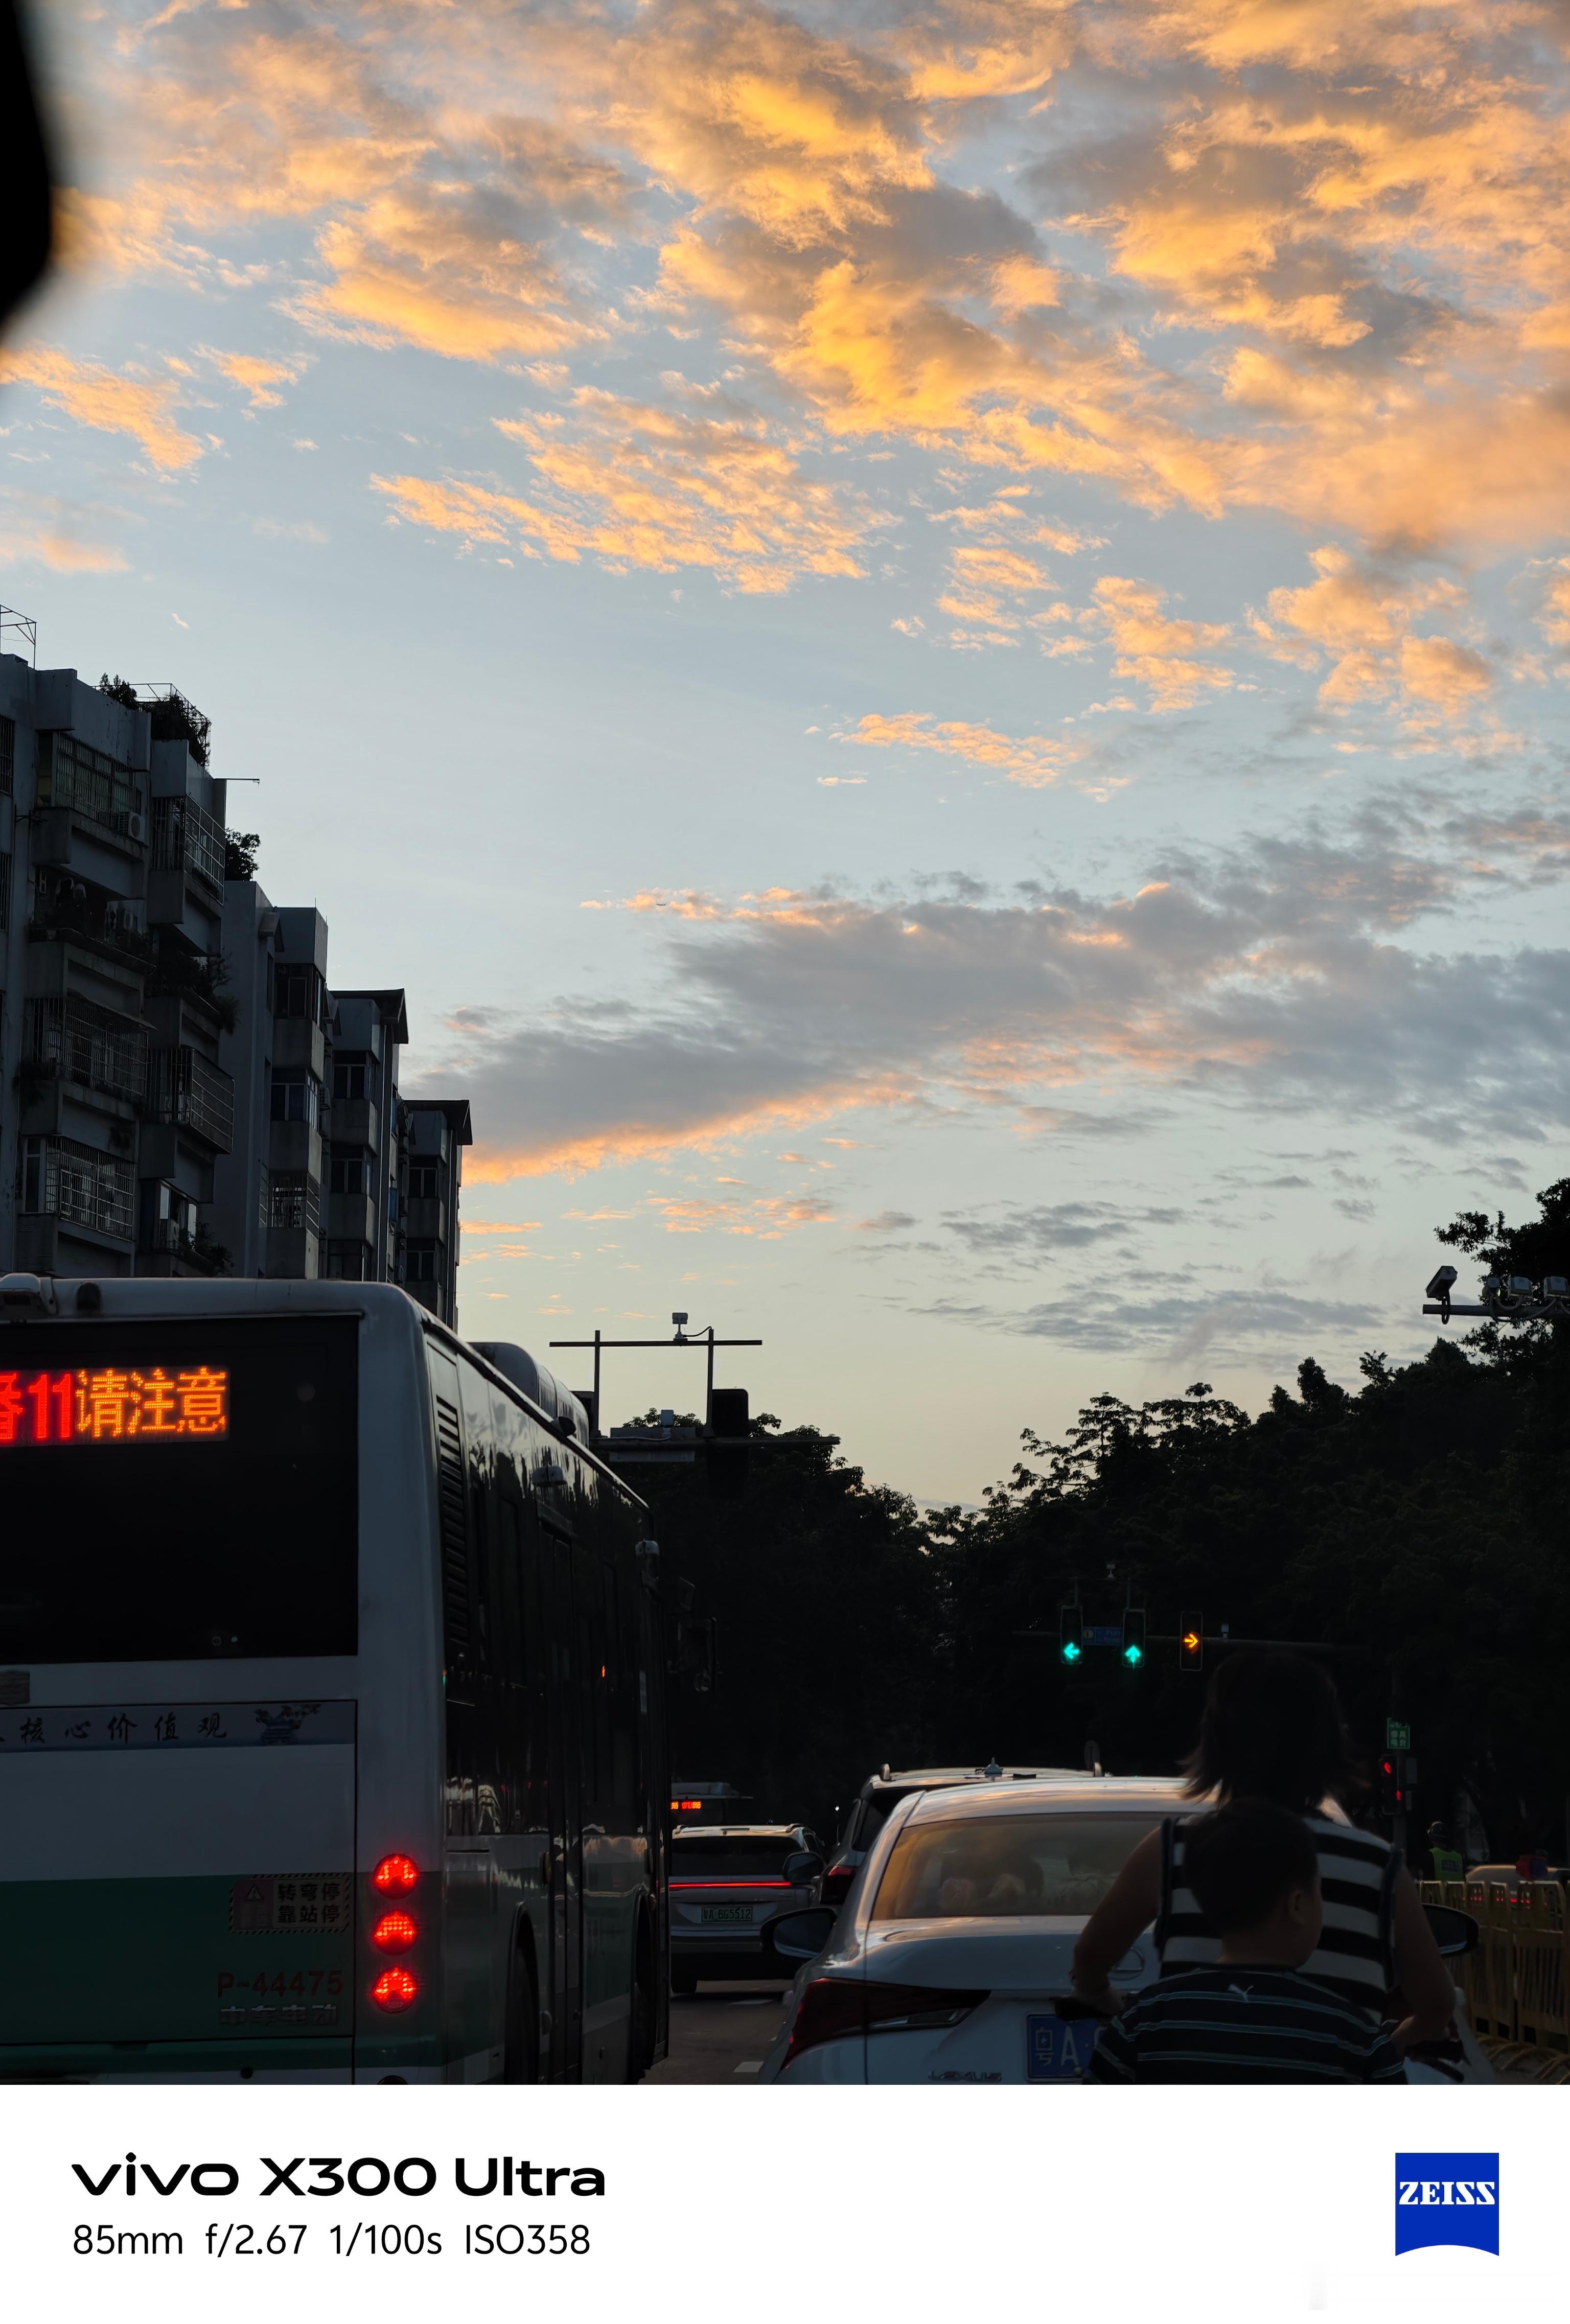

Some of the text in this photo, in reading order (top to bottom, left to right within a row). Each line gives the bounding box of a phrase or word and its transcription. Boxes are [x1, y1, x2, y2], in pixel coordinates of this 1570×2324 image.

[0, 1713, 226, 1744] 核心价值观
[278, 1882, 340, 1901] 转弯停
[277, 1904, 340, 1924] 靠站停
[217, 1970, 343, 1998] P-44475
